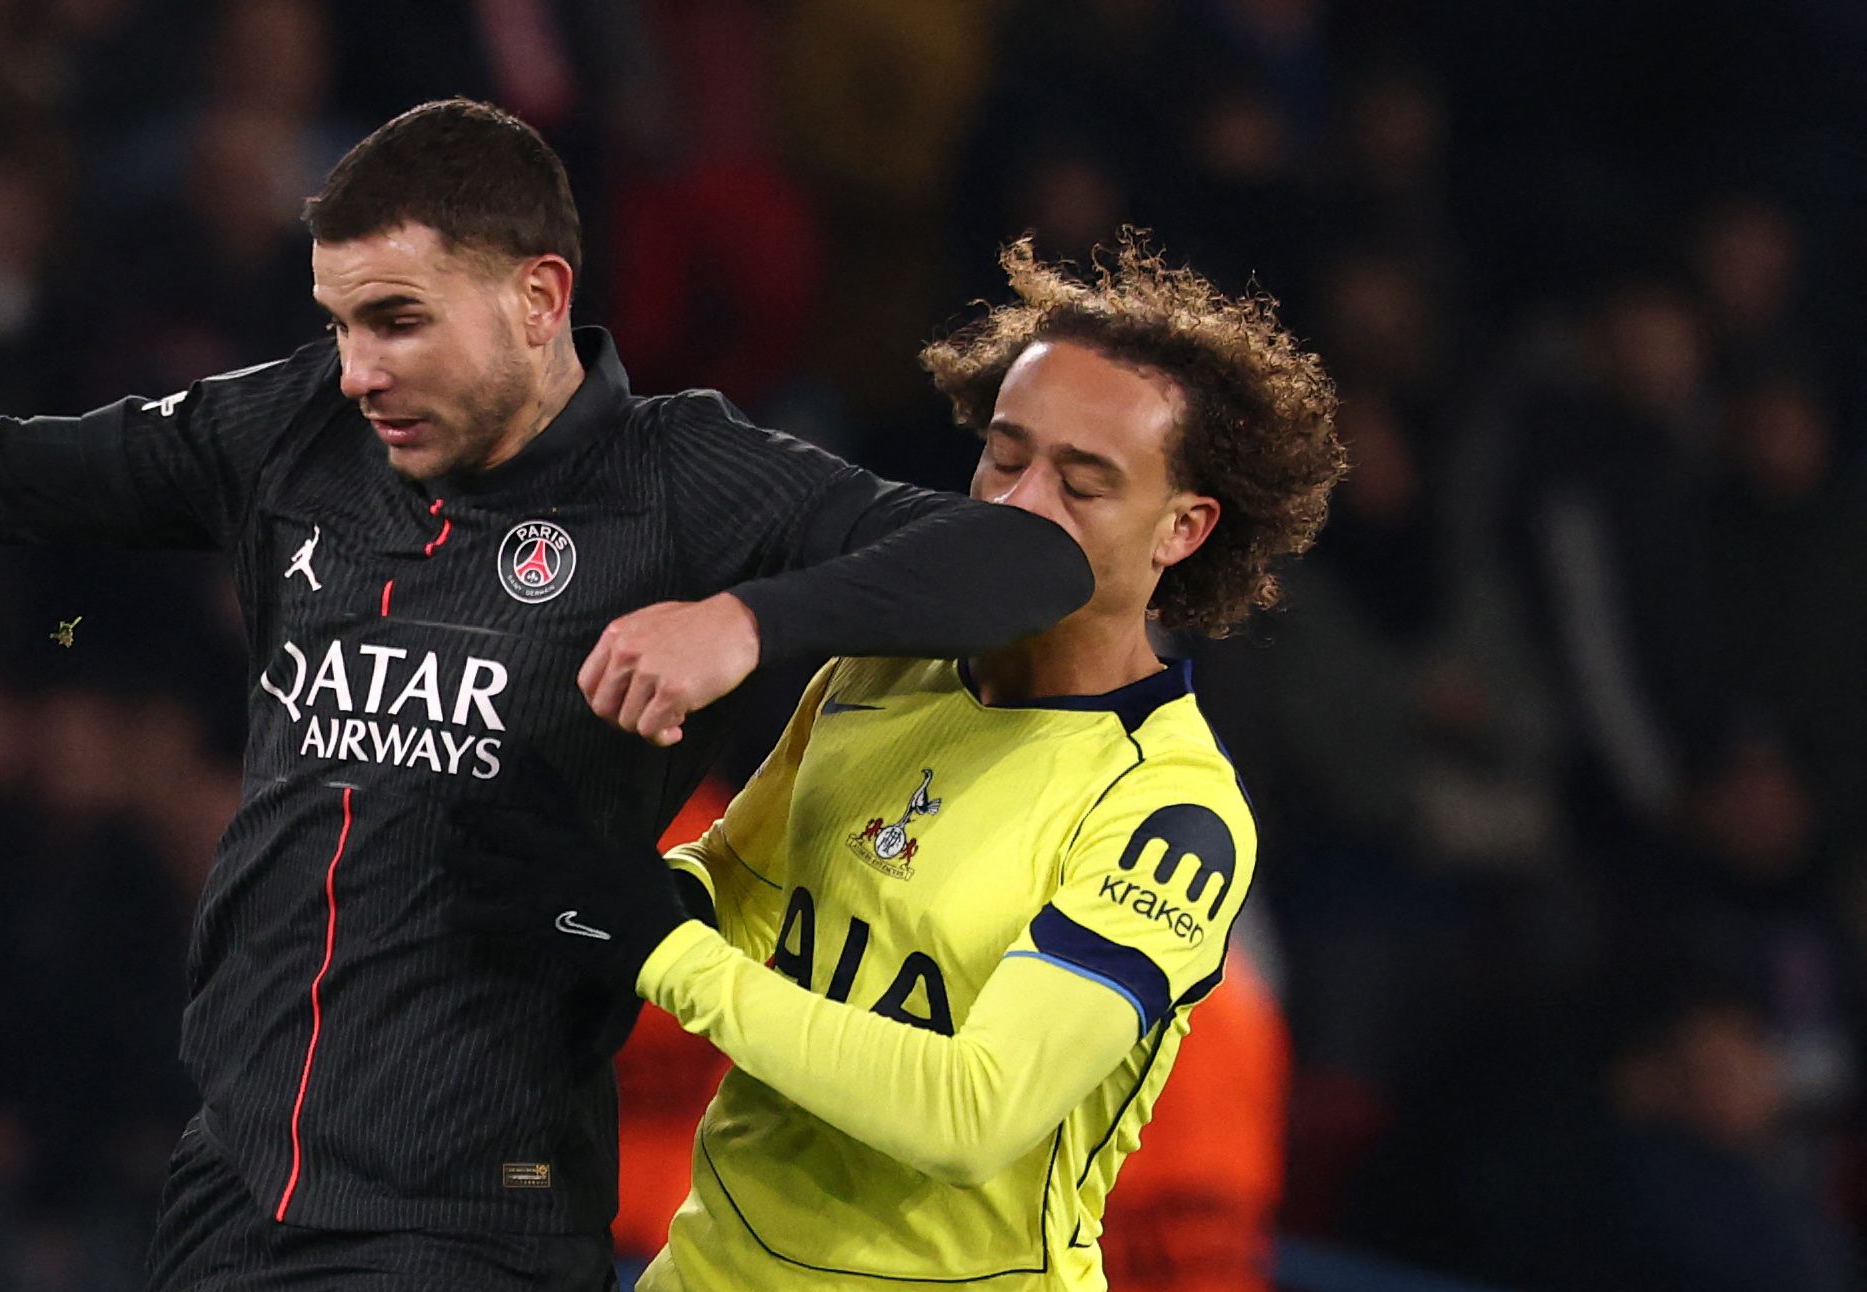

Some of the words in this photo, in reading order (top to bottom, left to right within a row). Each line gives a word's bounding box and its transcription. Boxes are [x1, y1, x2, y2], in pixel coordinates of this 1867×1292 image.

[516, 525, 567, 550] PARIS
[260, 639, 508, 732] QATAR
[300, 714, 502, 779] AIRWAYS
[1098, 874, 1205, 947] kraken
[773, 886, 955, 1038] AIA
